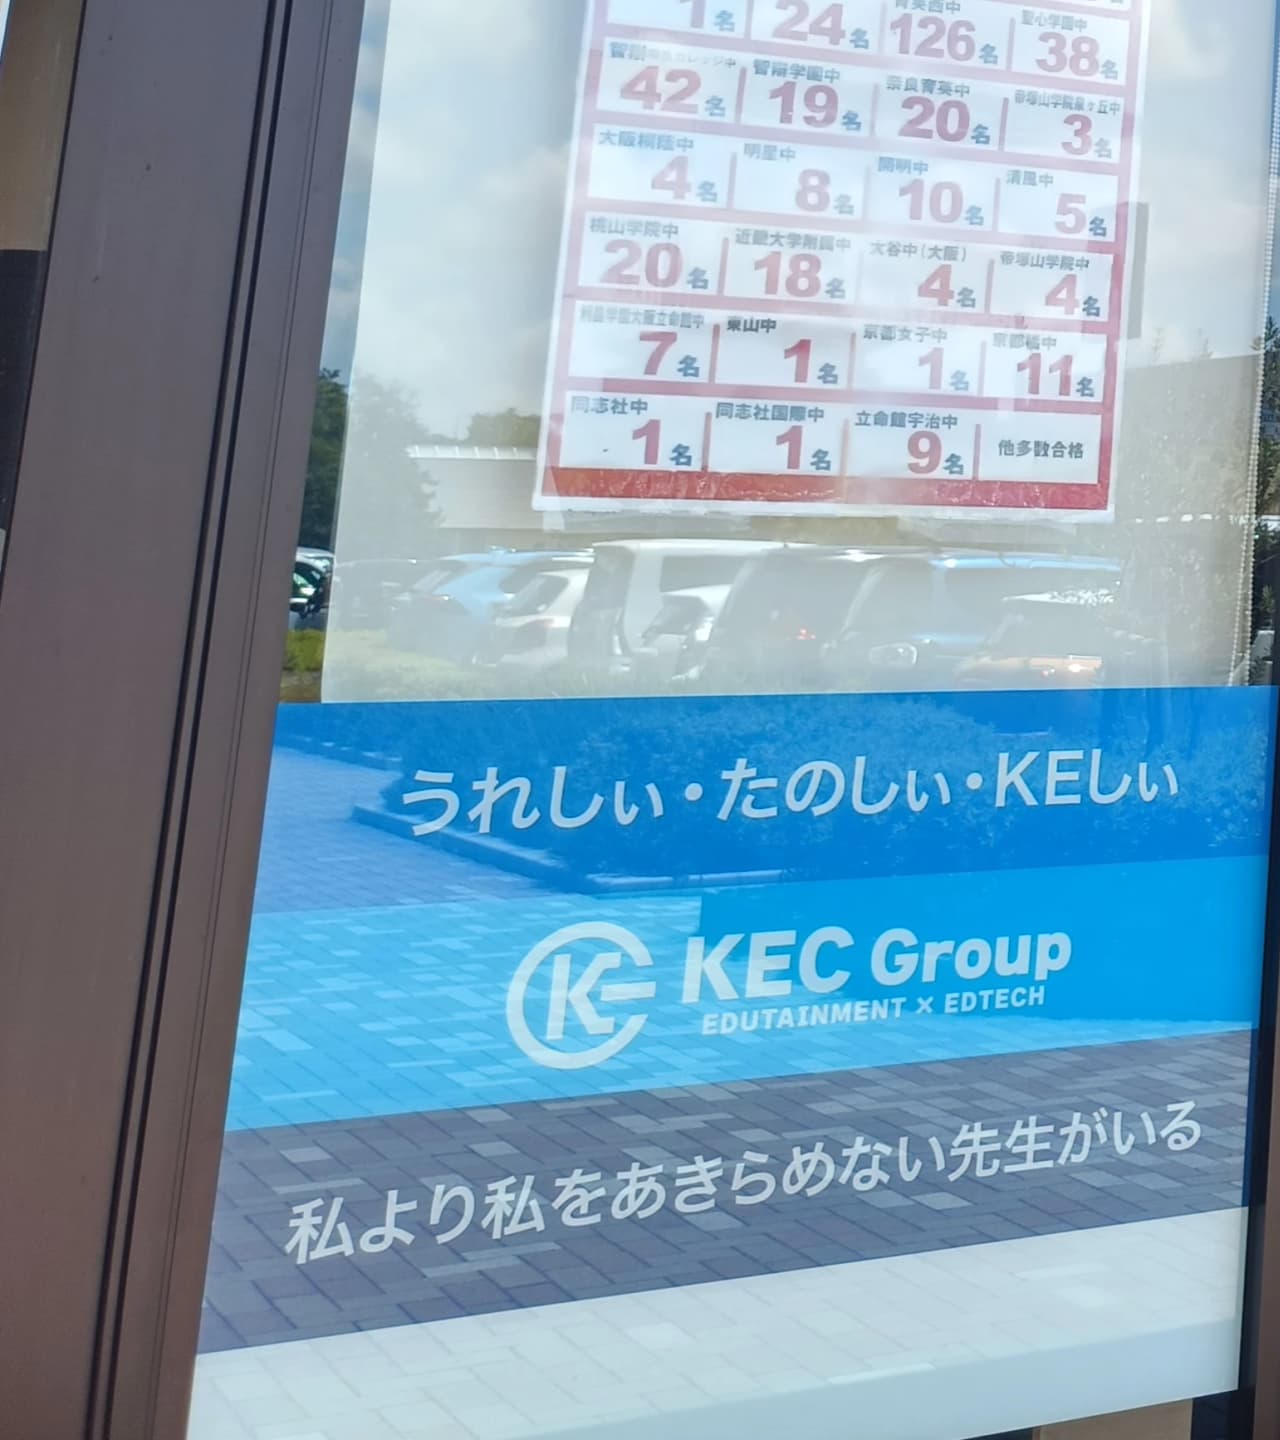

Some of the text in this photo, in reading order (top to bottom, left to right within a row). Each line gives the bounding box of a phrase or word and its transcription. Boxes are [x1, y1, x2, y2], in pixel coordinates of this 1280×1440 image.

[681, 924, 1073, 1004] KEC Group
[701, 984, 1046, 1036] EDUTAINMENT EDTECH
[283, 1100, 1203, 1265] 私より私をあきらめない先生がいる
